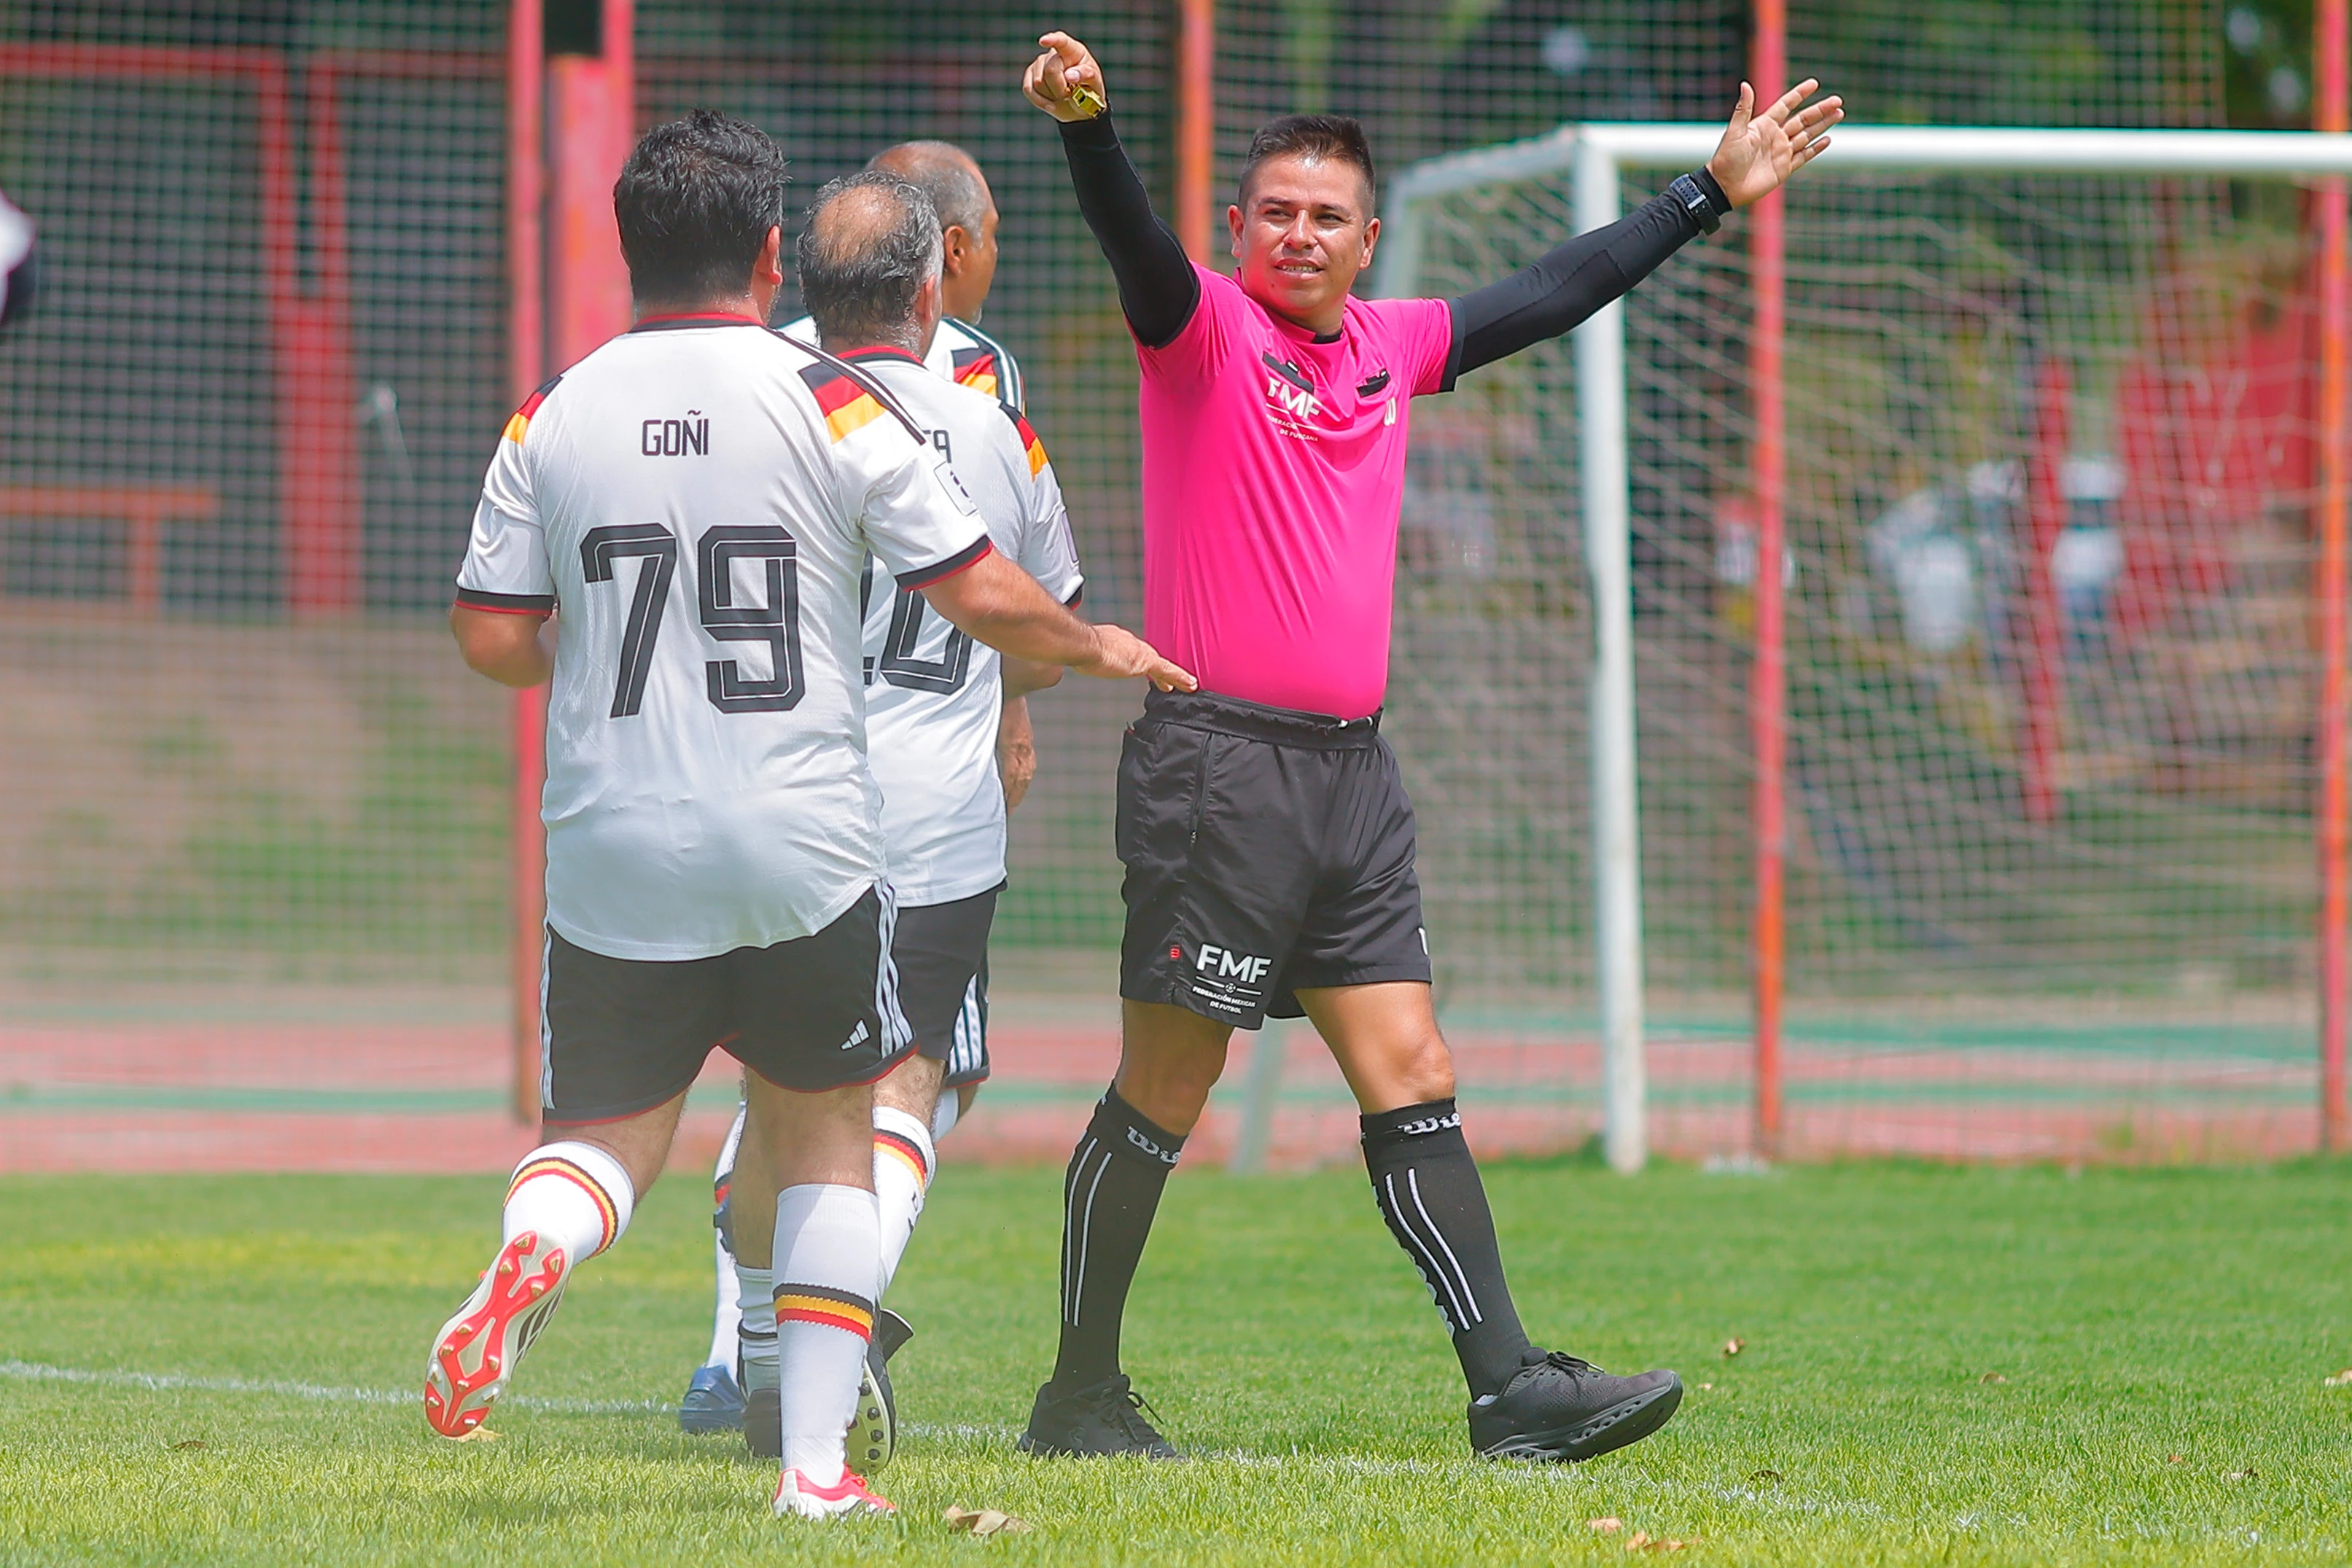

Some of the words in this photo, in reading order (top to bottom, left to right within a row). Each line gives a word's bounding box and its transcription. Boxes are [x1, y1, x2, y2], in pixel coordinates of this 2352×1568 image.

[642, 409, 709, 456] GOÑI
[921, 429, 952, 464] A
[580, 522, 806, 719] 79
[860, 547, 974, 696] 0
[1196, 943, 1272, 984] FMF
